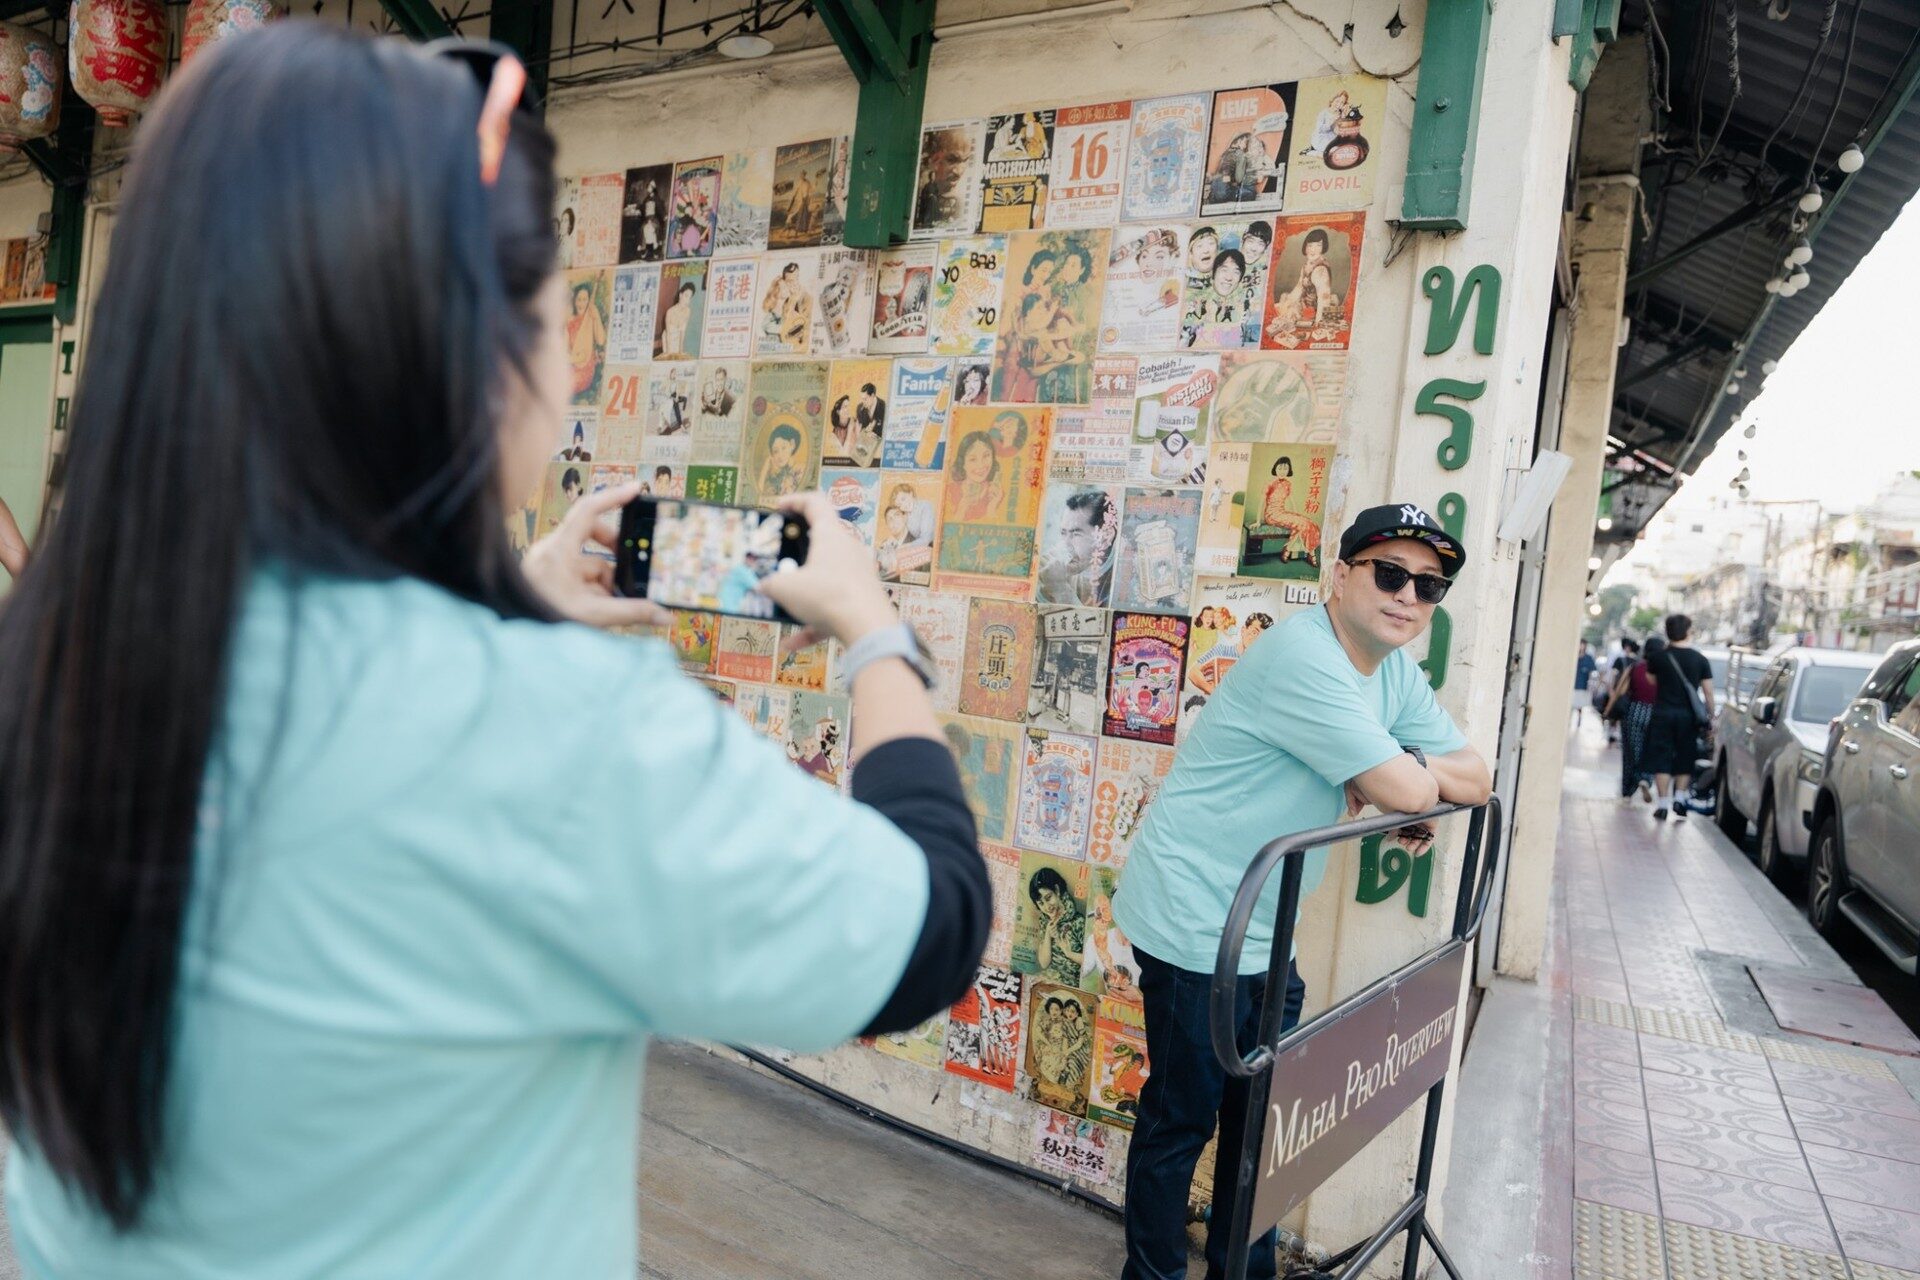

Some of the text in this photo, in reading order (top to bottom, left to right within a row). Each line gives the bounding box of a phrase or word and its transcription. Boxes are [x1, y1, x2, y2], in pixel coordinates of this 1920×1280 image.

[1069, 131, 1108, 181] 16
[1299, 175, 1362, 194] BOVRIL
[715, 273, 751, 302] 香港
[941, 265, 960, 285] YO
[605, 374, 639, 417] 24
[901, 374, 943, 394] Fanta
[1400, 505, 1427, 526] NY
[1266, 1005, 1457, 1178] MAHA PHO RIVERVIEW
